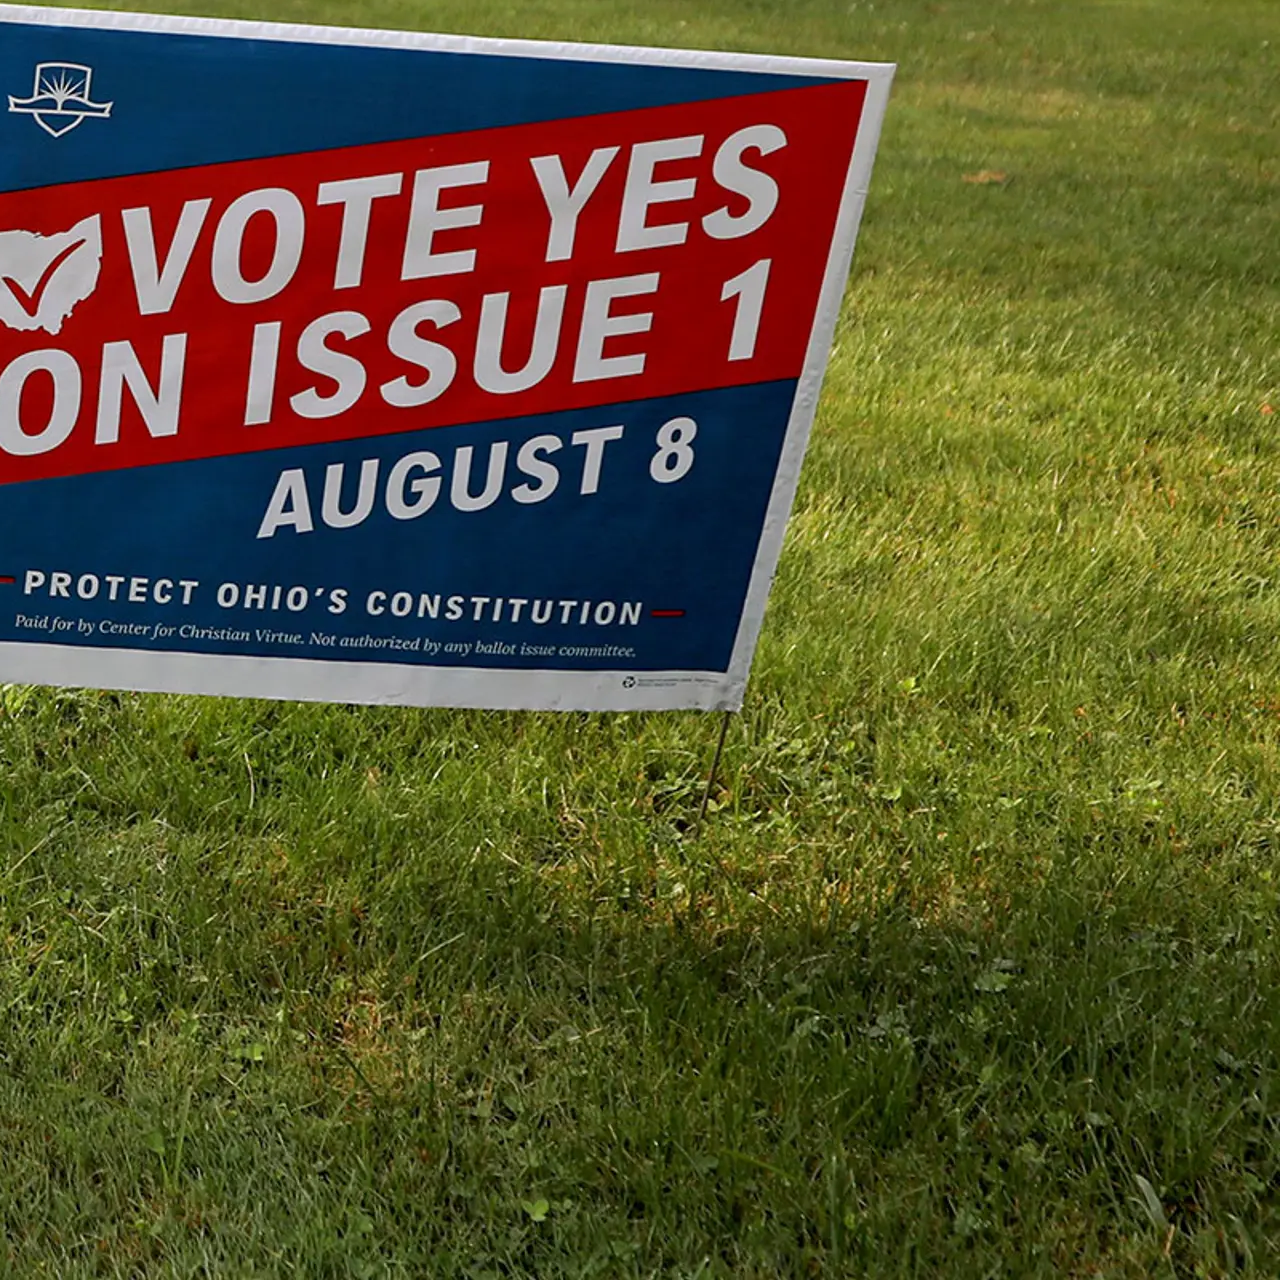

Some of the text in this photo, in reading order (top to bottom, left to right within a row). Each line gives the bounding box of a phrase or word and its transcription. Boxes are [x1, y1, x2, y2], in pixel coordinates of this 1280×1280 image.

[121, 124, 788, 315] VOTE YES
[244, 271, 658, 426] ISSUE
[720, 258, 772, 362] 1
[256, 416, 695, 539] AUGUST 8
[15, 614, 637, 658] Paid for by Center for Christian Virtue. Not authorized by any ballot issue committee.
[24, 570, 642, 625] PROTECT OHIO'S CONSTITUTION
